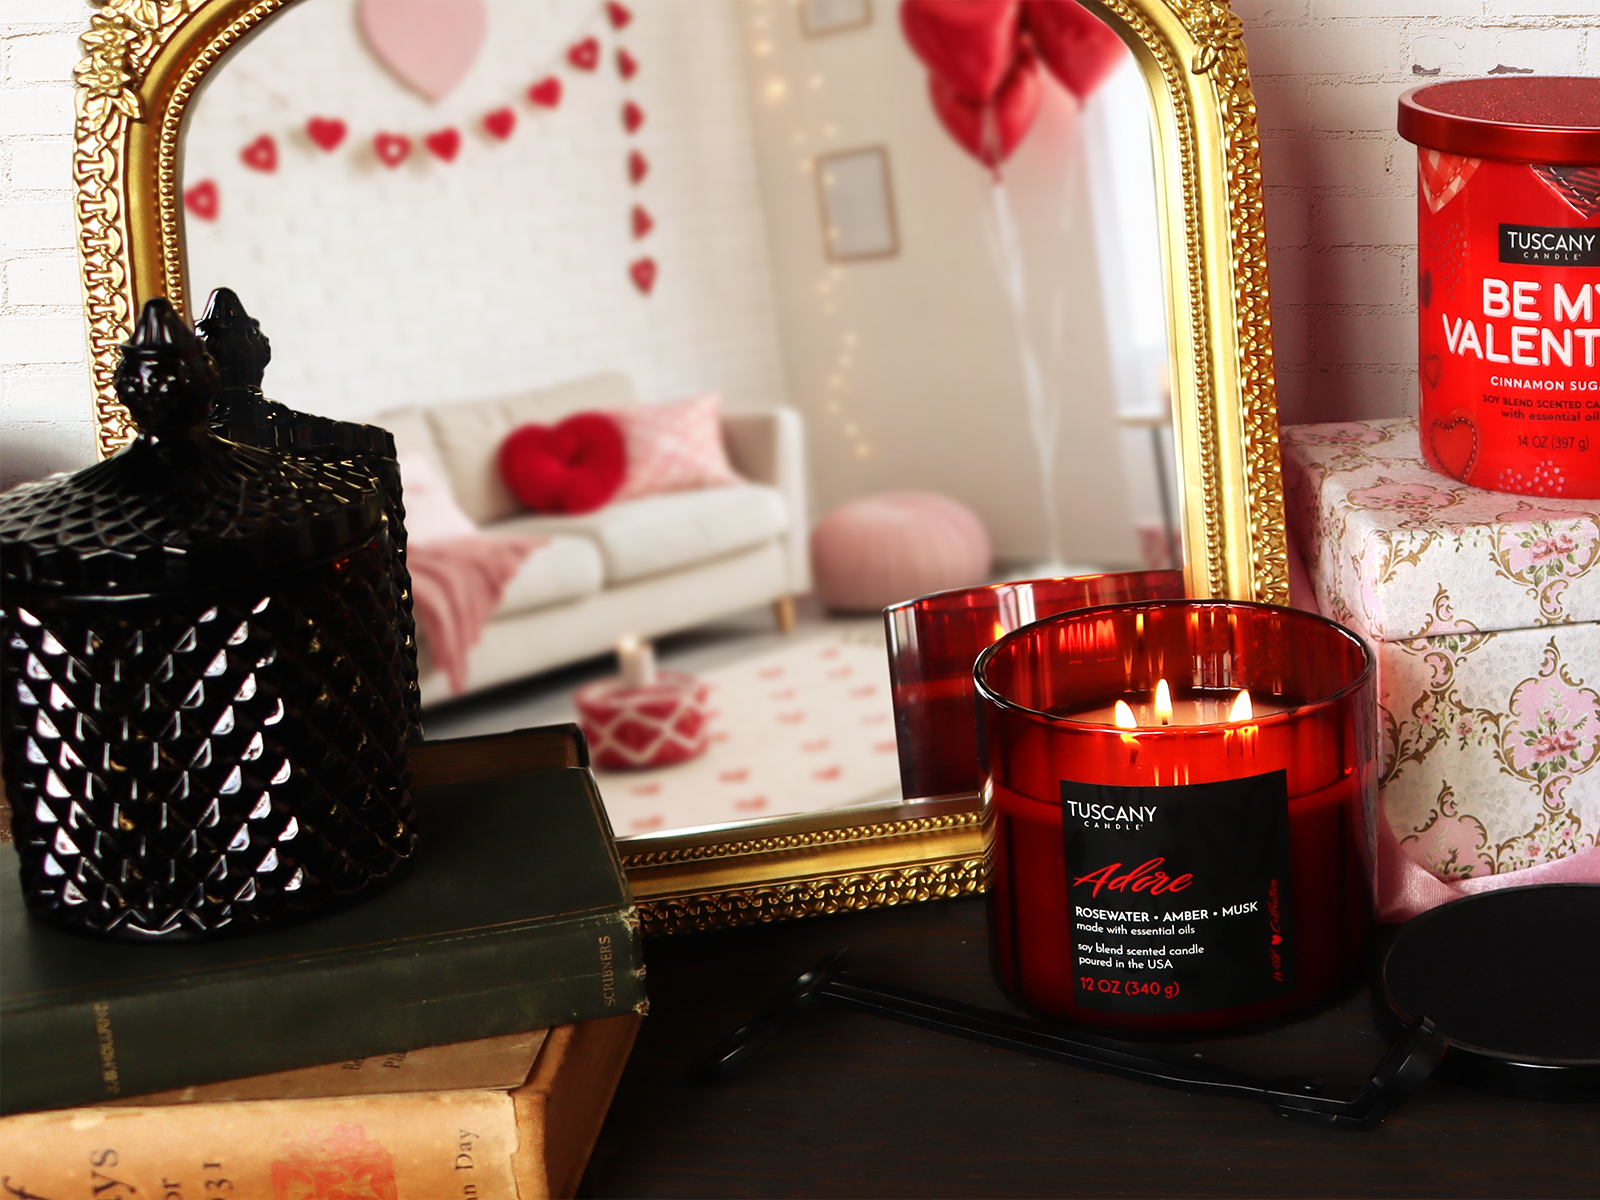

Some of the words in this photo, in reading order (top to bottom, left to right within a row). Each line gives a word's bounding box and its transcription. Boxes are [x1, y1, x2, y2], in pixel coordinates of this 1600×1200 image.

[1507, 231, 1596, 252] TUSCANY
[1523, 252, 1580, 261] CANDLE
[1482, 278, 1541, 321] BE
[1490, 376, 1565, 391] CINNAMON
[1482, 394, 1500, 405] SOY
[1503, 396, 1533, 408] BLEND
[1536, 399, 1582, 409] SCENTED
[1501, 409, 1525, 420] with
[1529, 411, 1580, 422] essential
[1517, 435, 1529, 448] 14
[1532, 436, 1548, 448] OZ
[1551, 435, 1575, 451] (397
[1067, 800, 1158, 822] TUSCANY
[1084, 820, 1142, 831] CANDLE
[1073, 857, 1194, 899] Adore
[1075, 905, 1150, 922] ROSEWATER
[1163, 909, 1208, 922] AMBER
[1222, 901, 1259, 917] MUSK
[1076, 922, 1104, 933] made
[1106, 924, 1128, 935] with
[1131, 925, 1175, 936] essential
[1178, 925, 1195, 935] oils
[1077, 943, 1093, 954] soy
[1095, 942, 1124, 956] blend
[1126, 944, 1166, 956] scented
[1169, 943, 1205, 956] candle
[598, 935, 616, 1007] SCRIBNERS
[1079, 956, 1112, 968] poured
[1115, 957, 1125, 968] in
[1127, 957, 1144, 969] the
[1147, 958, 1174, 970] USA
[1080, 976, 1094, 991] 12
[1098, 979, 1121, 995] OZ
[1124, 980, 1160, 996] (340
[1164, 981, 1180, 999] g)
[455, 1129, 480, 1170] Day
